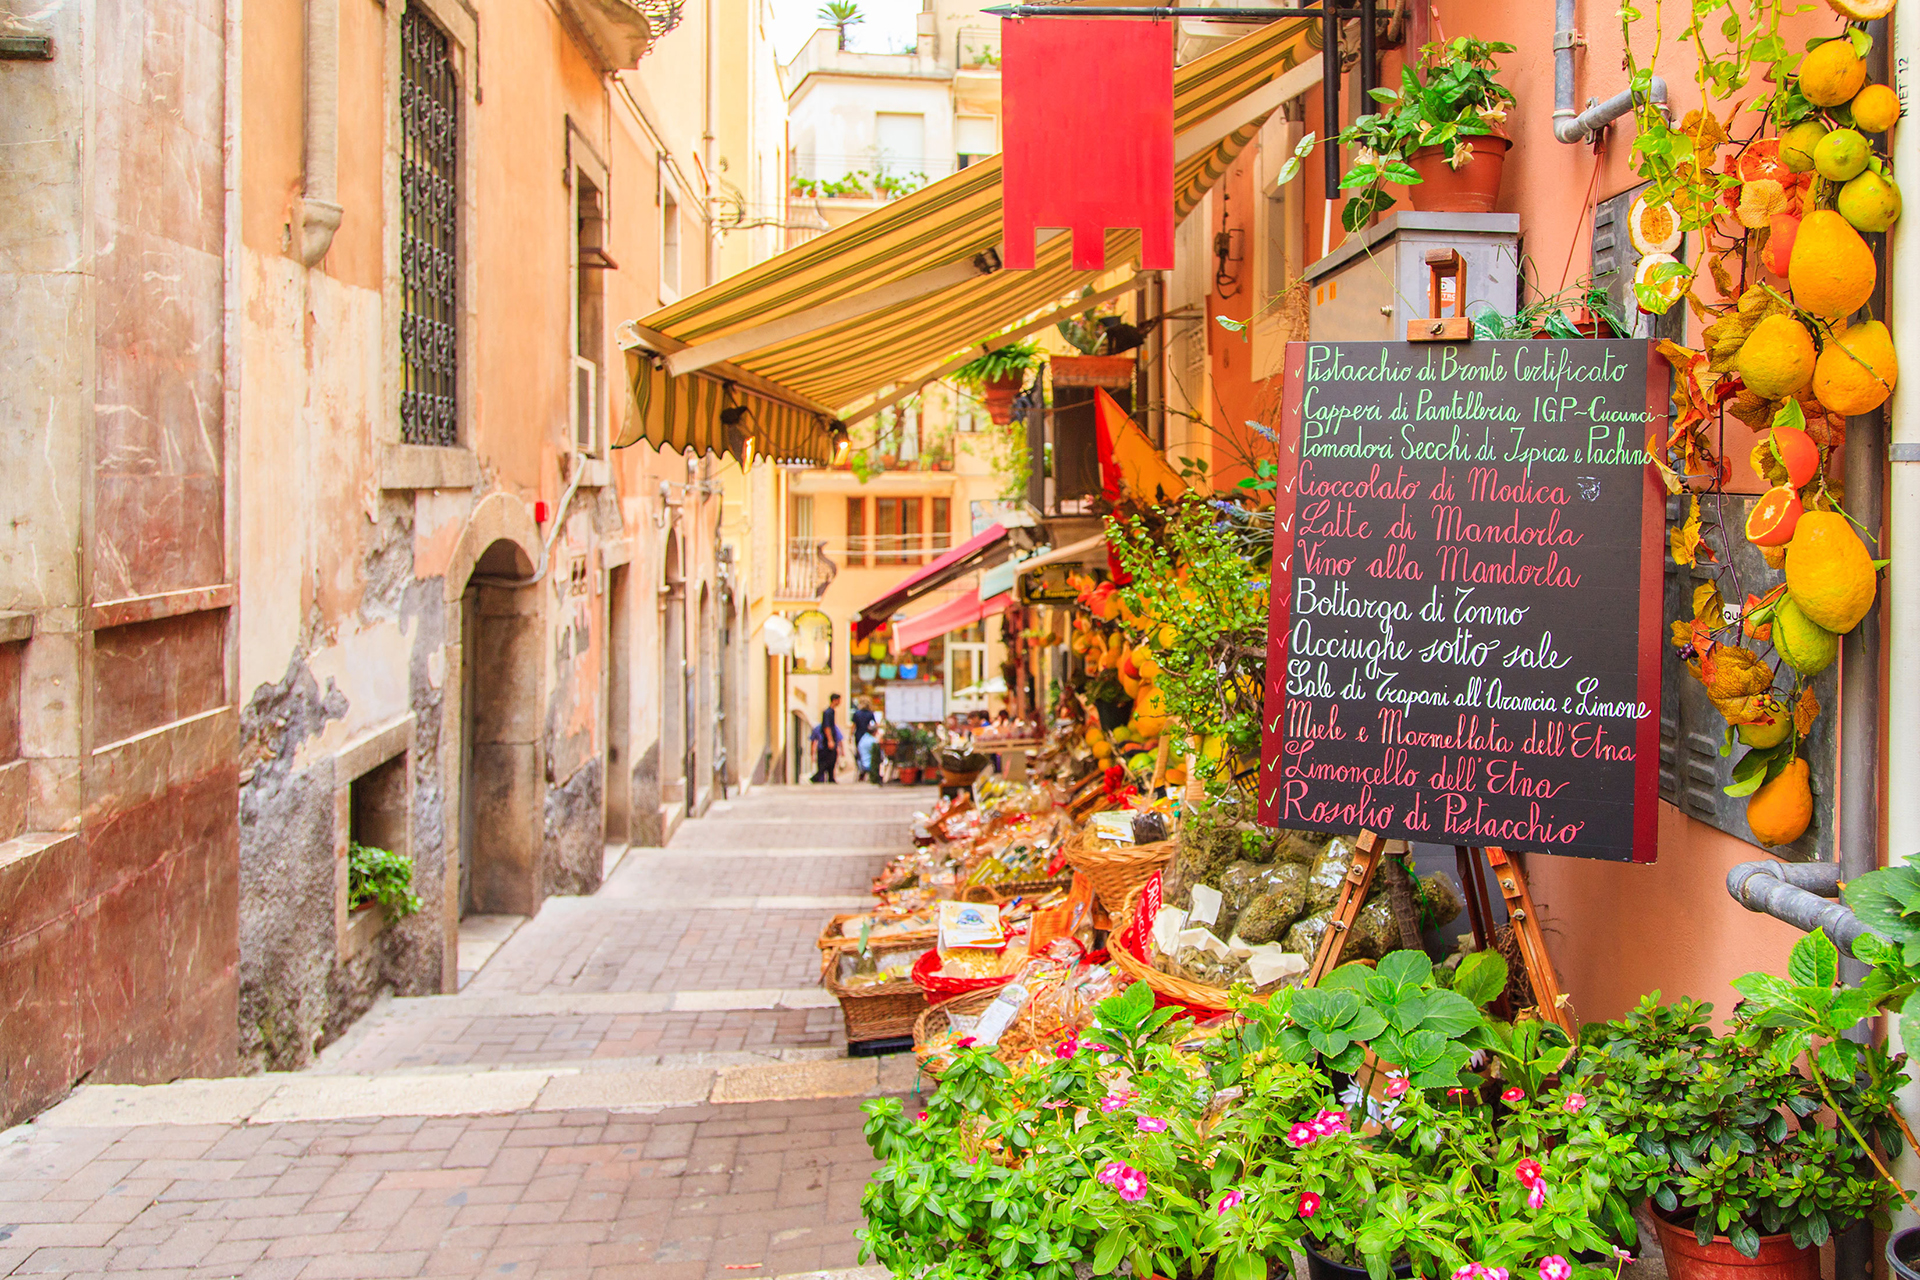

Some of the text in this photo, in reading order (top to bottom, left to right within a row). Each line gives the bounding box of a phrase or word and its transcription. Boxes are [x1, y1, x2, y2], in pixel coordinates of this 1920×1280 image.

[1307, 345, 1629, 393] Pistacchio di Bronte Certificato
[1303, 386, 1383, 435] Capperi
[1388, 392, 1409, 421] di
[1416, 388, 1522, 422] Pantelleria
[1302, 421, 1395, 458] Pomodori
[1400, 423, 1472, 461] Secchi
[1474, 427, 1497, 461] di
[1503, 427, 1570, 479] Ispica
[1573, 449, 1584, 464] e
[1298, 459, 1572, 505] Cioccolato di Modica
[1299, 499, 1585, 547] Latte di Mandorla
[1297, 539, 1582, 588] Vino alla Mandorla
[1296, 577, 1531, 634] Bottarga di Tonno
[1292, 618, 1573, 680] Acciughe sotto sale
[1285, 658, 1336, 698] Sale
[1340, 667, 1367, 700] di
[1375, 667, 1450, 718] Trapani
[1562, 697, 1573, 715] e
[1575, 676, 1652, 719] Limone
[1287, 698, 1347, 741] Miele
[1355, 726, 1369, 743] e
[1378, 707, 1515, 753] Marmellata
[1284, 739, 1421, 787] Limoncello
[1282, 779, 1585, 844] Rosolio di Pistacchio
